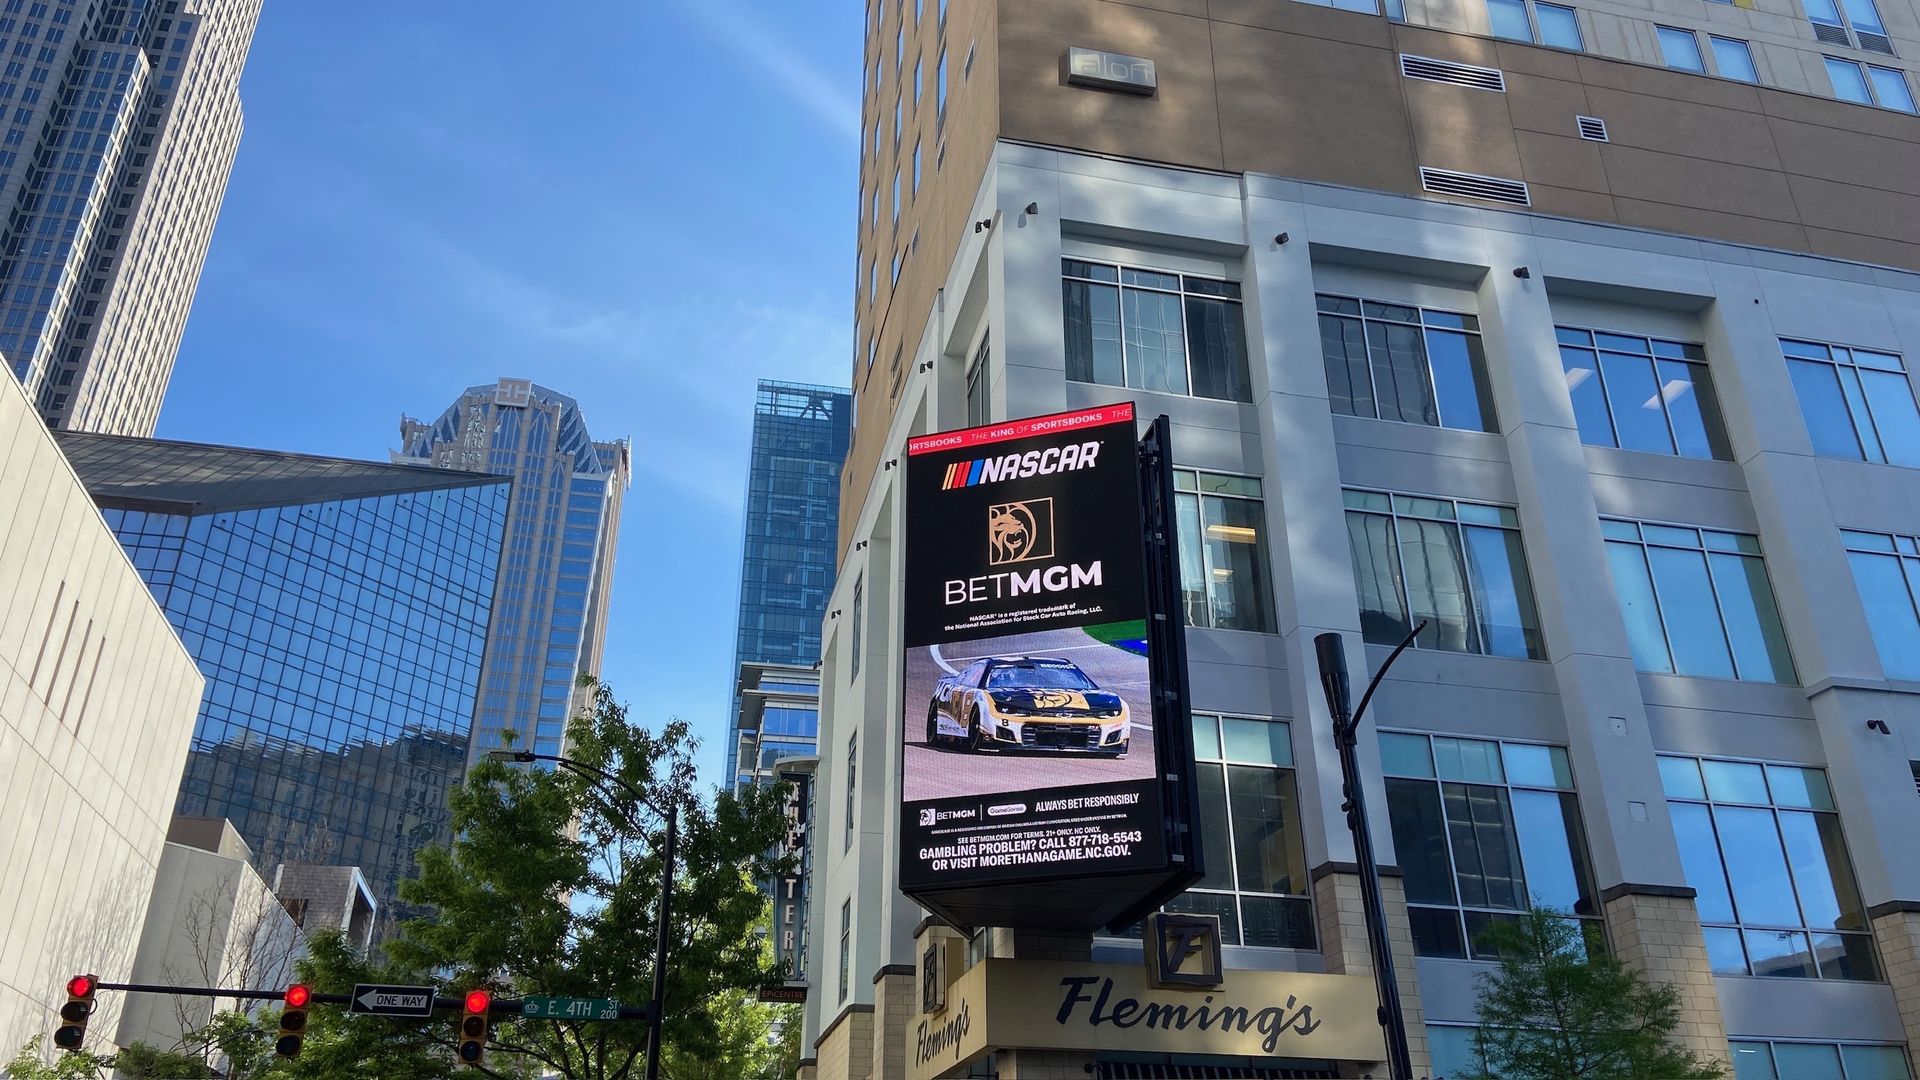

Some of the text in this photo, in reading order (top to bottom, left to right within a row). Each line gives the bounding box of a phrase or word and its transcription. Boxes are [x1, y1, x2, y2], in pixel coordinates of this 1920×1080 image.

[909, 408, 1131, 452] RTSBOOKS THE KING OF SPORTSBOOKS THE
[945, 560, 1103, 606] BETMGM
[1009, 608, 1038, 617] registered
[1038, 604, 1069, 613] trademark
[955, 622, 979, 630] National
[980, 618, 1013, 627] Association
[1022, 614, 1040, 622] Stock
[1001, 718, 1009, 727] 8
[1035, 793, 1140, 812] ALWAYS BET RESPONSIBLY
[936, 809, 976, 821] BETMGM
[919, 830, 1142, 860] GAMBLING PROBLEM? CALL 877-718-5543
[957, 837, 969, 845] SEE
[969, 833, 1010, 844] BETMGM.COM
[1010, 832, 1023, 840] FOR
[1056, 828, 1074, 836] ONLY.
[1084, 826, 1102, 834] ONLY.
[932, 844, 1132, 871] OR VISIT MORETHANAGAME.NC.GOV.
[376, 994, 425, 1007] ONE WAY
[547, 1000, 619, 1017] E. 4TH ST
[600, 1009, 618, 1020] 200
[1055, 976, 1322, 1053] Fleming's
[915, 997, 971, 1069] Fleming's
